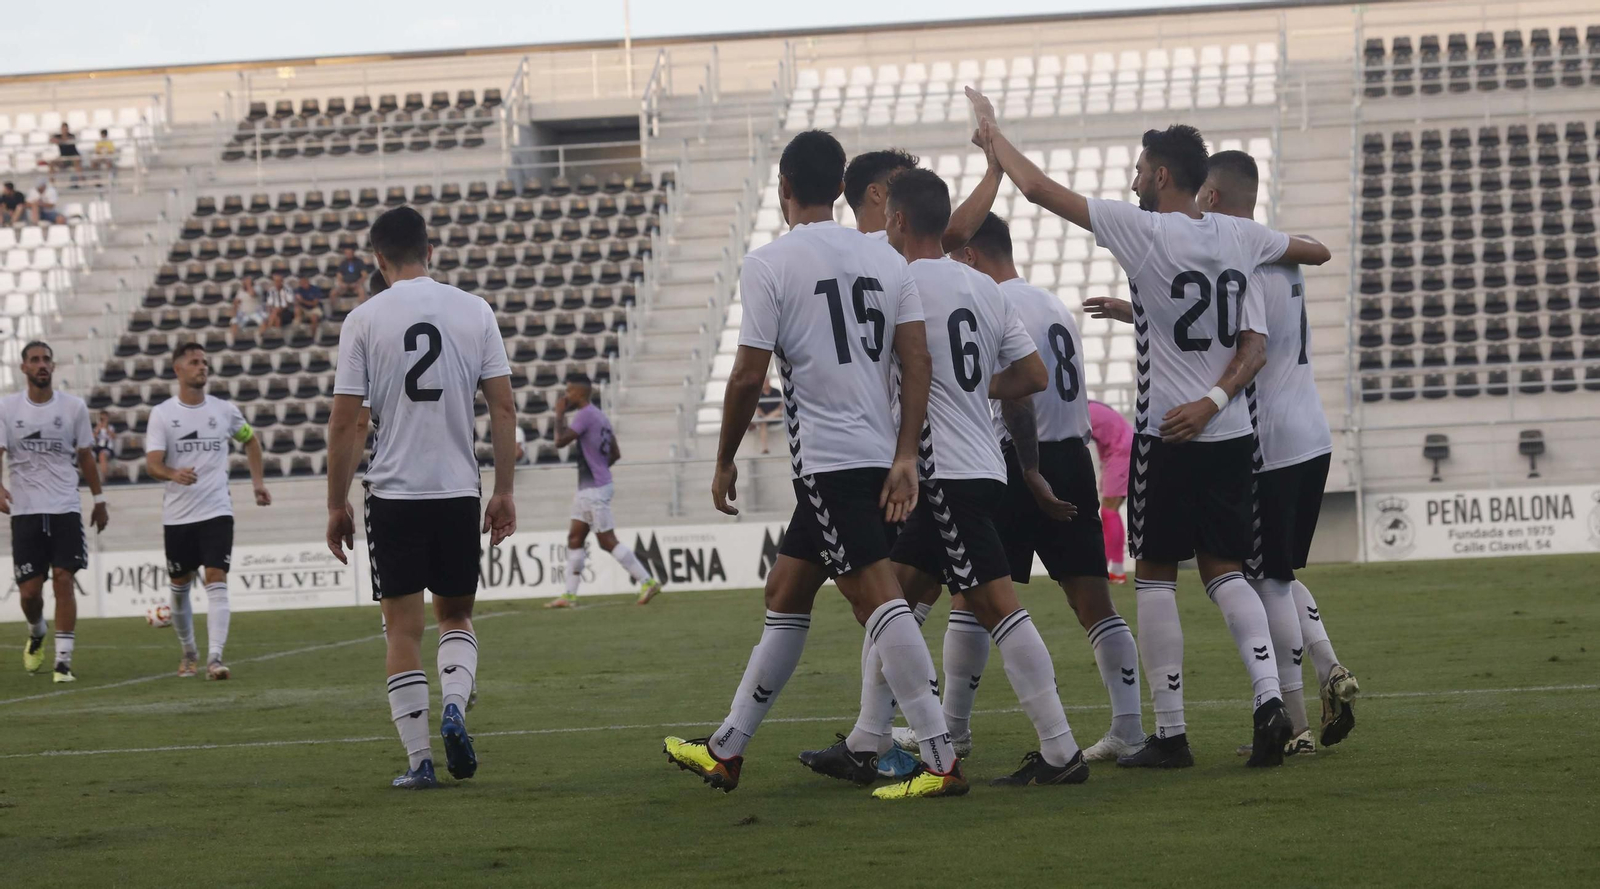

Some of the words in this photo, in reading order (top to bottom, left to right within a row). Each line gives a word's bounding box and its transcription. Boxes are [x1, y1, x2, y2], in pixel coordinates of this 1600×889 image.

[814, 276, 885, 365] 15
[1171, 268, 1247, 352] 20
[403, 322, 444, 402] 2
[947, 308, 983, 392] 6
[1047, 323, 1080, 402] 8
[175, 440, 221, 453] LOTUS
[1427, 494, 1483, 525] PEÑA
[1489, 494, 1574, 523] BALONA
[1448, 528, 1503, 540] Fundada
[1507, 529, 1524, 537] en
[1453, 542, 1485, 554] Calle
[21, 562, 34, 575] 22
[629, 531, 727, 586] MENA
[238, 570, 346, 591] VELVET
